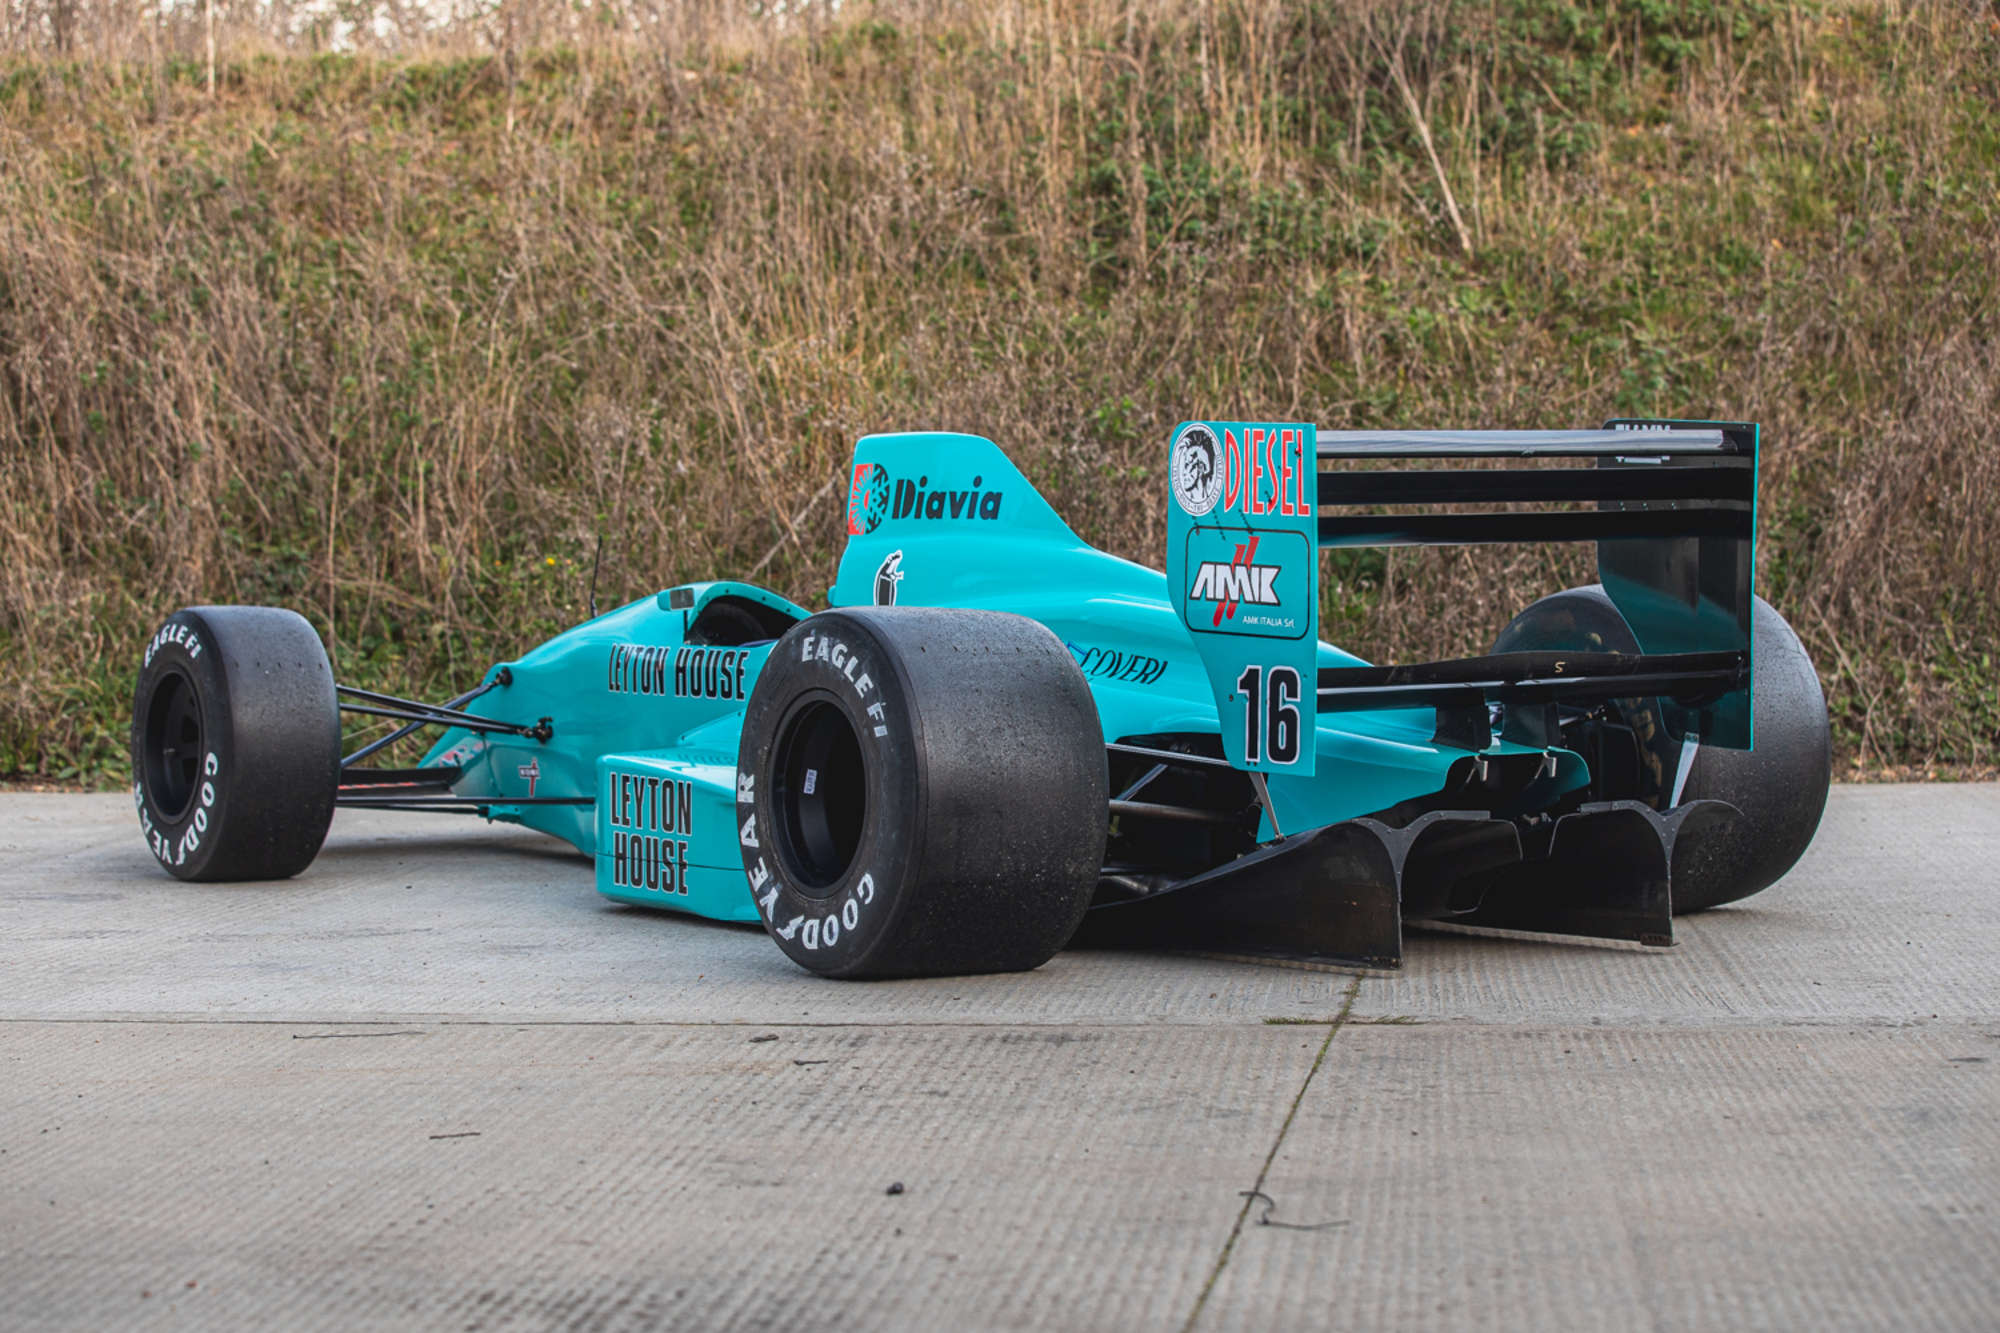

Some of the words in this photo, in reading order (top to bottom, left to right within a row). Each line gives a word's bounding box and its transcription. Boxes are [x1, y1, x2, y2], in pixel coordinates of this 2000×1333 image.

[892, 475, 1003, 520] Diavia
[1224, 428, 1311, 517] DIESEL
[1189, 561, 1282, 606] AMK
[144, 623, 188, 668] EAGLE
[1260, 616, 1282, 627] ITALIA
[608, 643, 670, 696] LEYTON
[674, 647, 750, 701] HOUSE
[801, 636, 874, 698] EAGLE
[1236, 664, 1301, 765] 16
[135, 751, 218, 865] GOODYEAR
[610, 771, 693, 837] LEYTON
[613, 830, 689, 896] HOUSE
[737, 772, 875, 950] GOODYEAR
